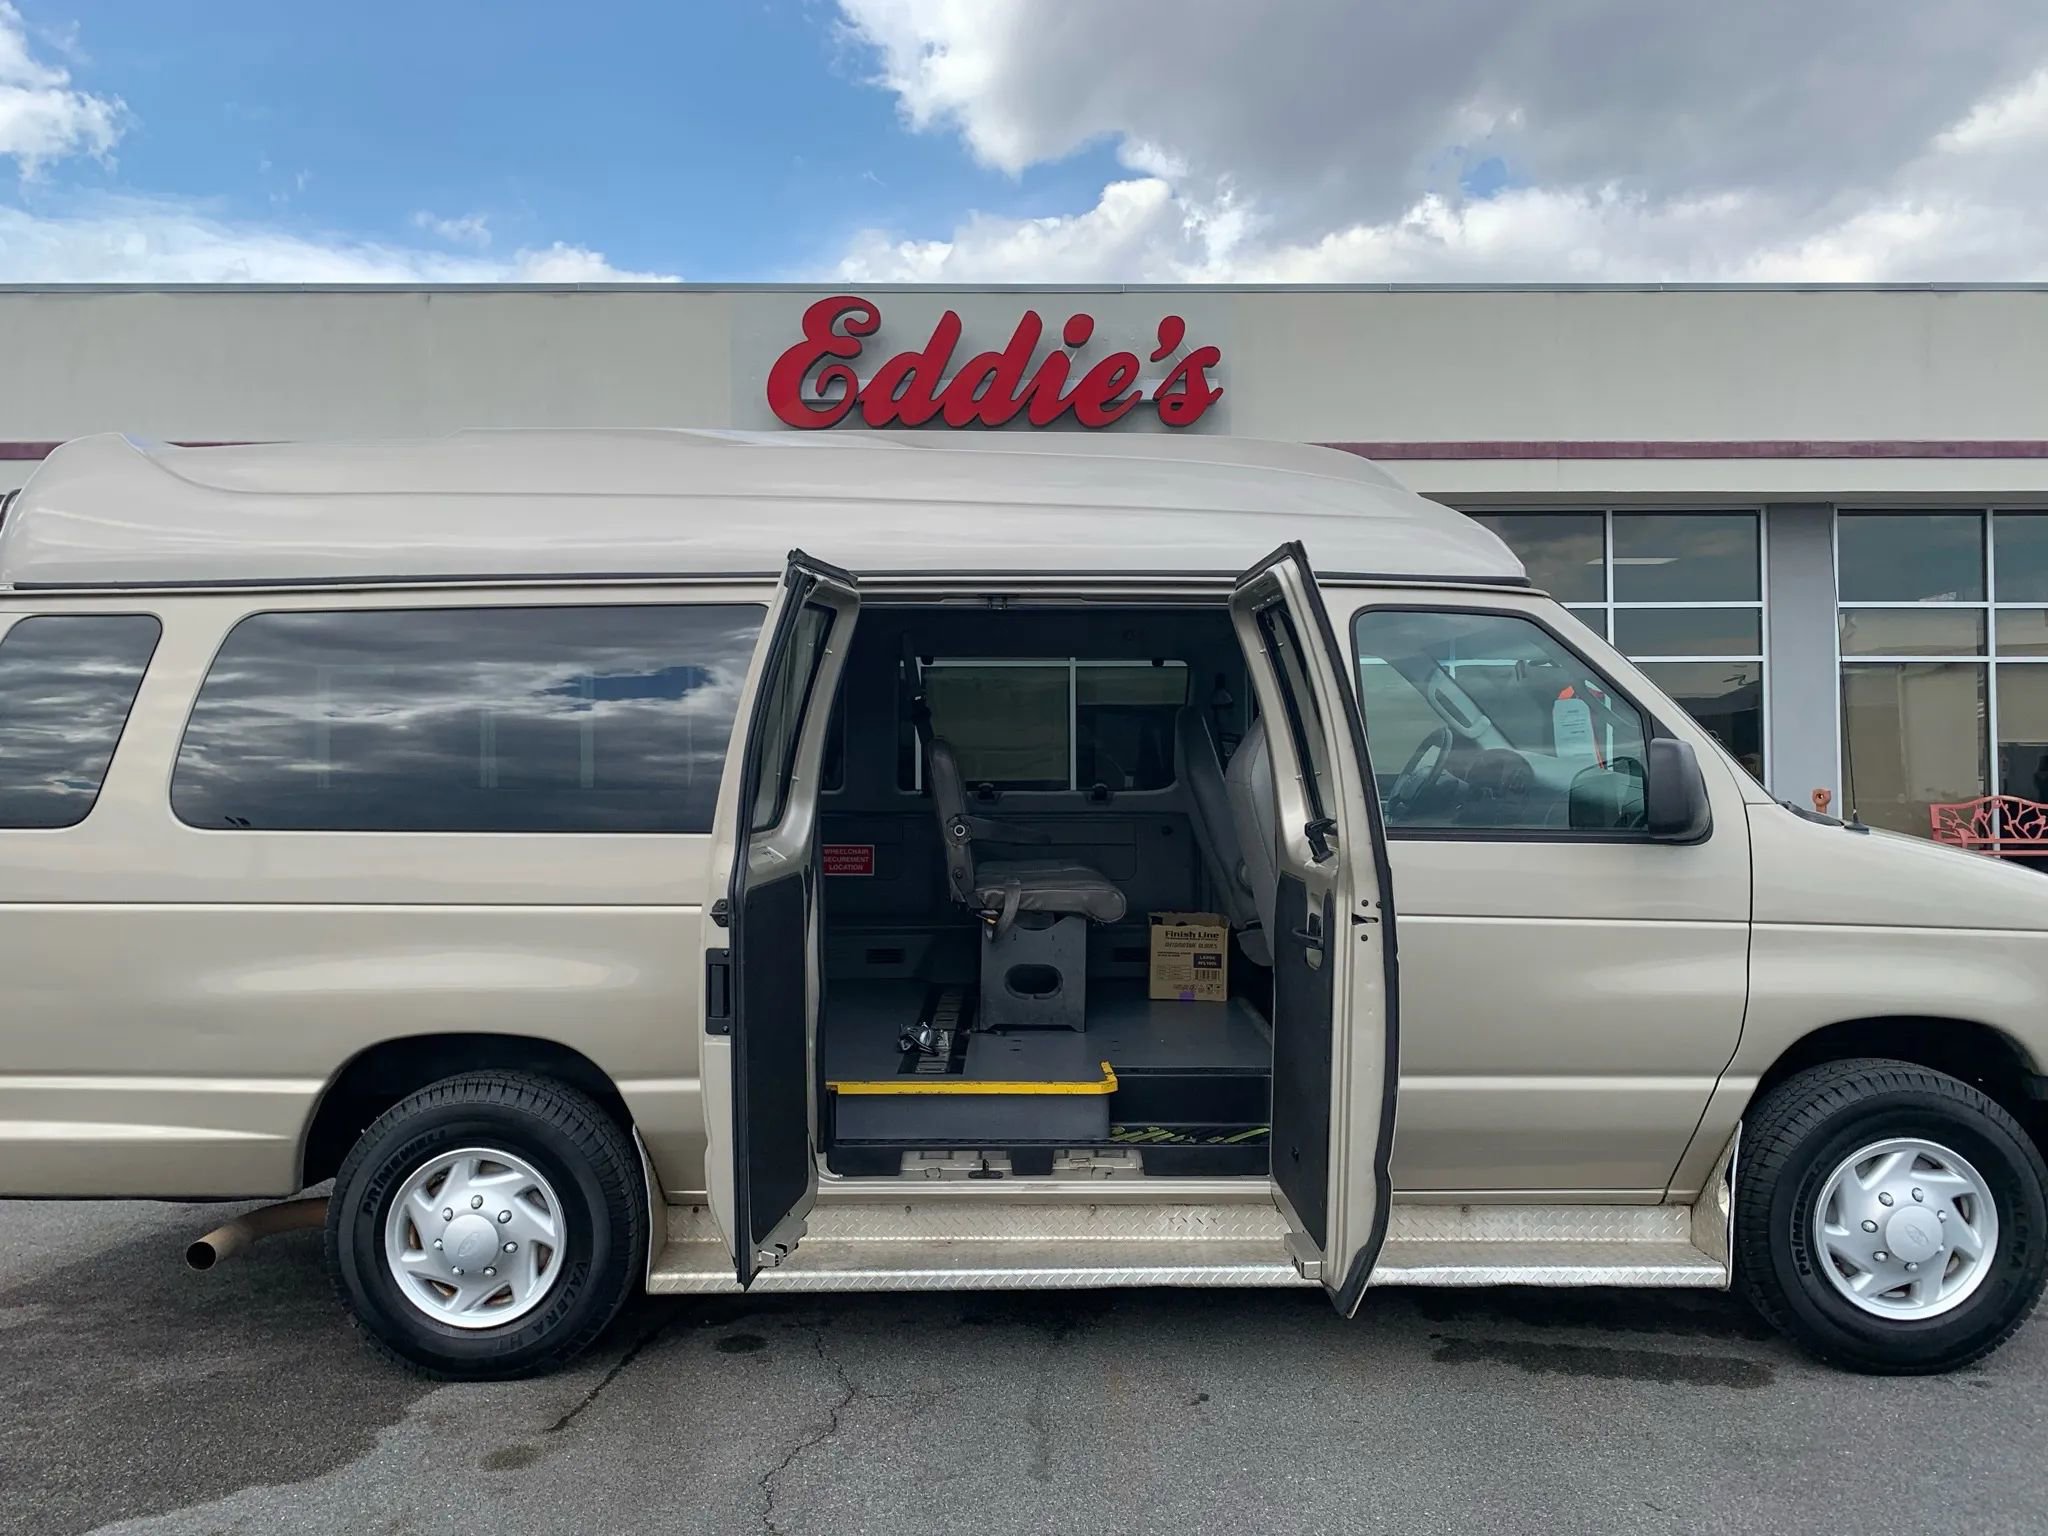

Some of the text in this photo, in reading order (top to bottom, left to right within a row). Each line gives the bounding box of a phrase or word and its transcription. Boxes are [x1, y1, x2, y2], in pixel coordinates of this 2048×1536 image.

[766, 296, 1223, 429] Eddie's
[1165, 930, 1219, 939] Finish Line
[362, 1129, 446, 1218] PRIMEWELL
